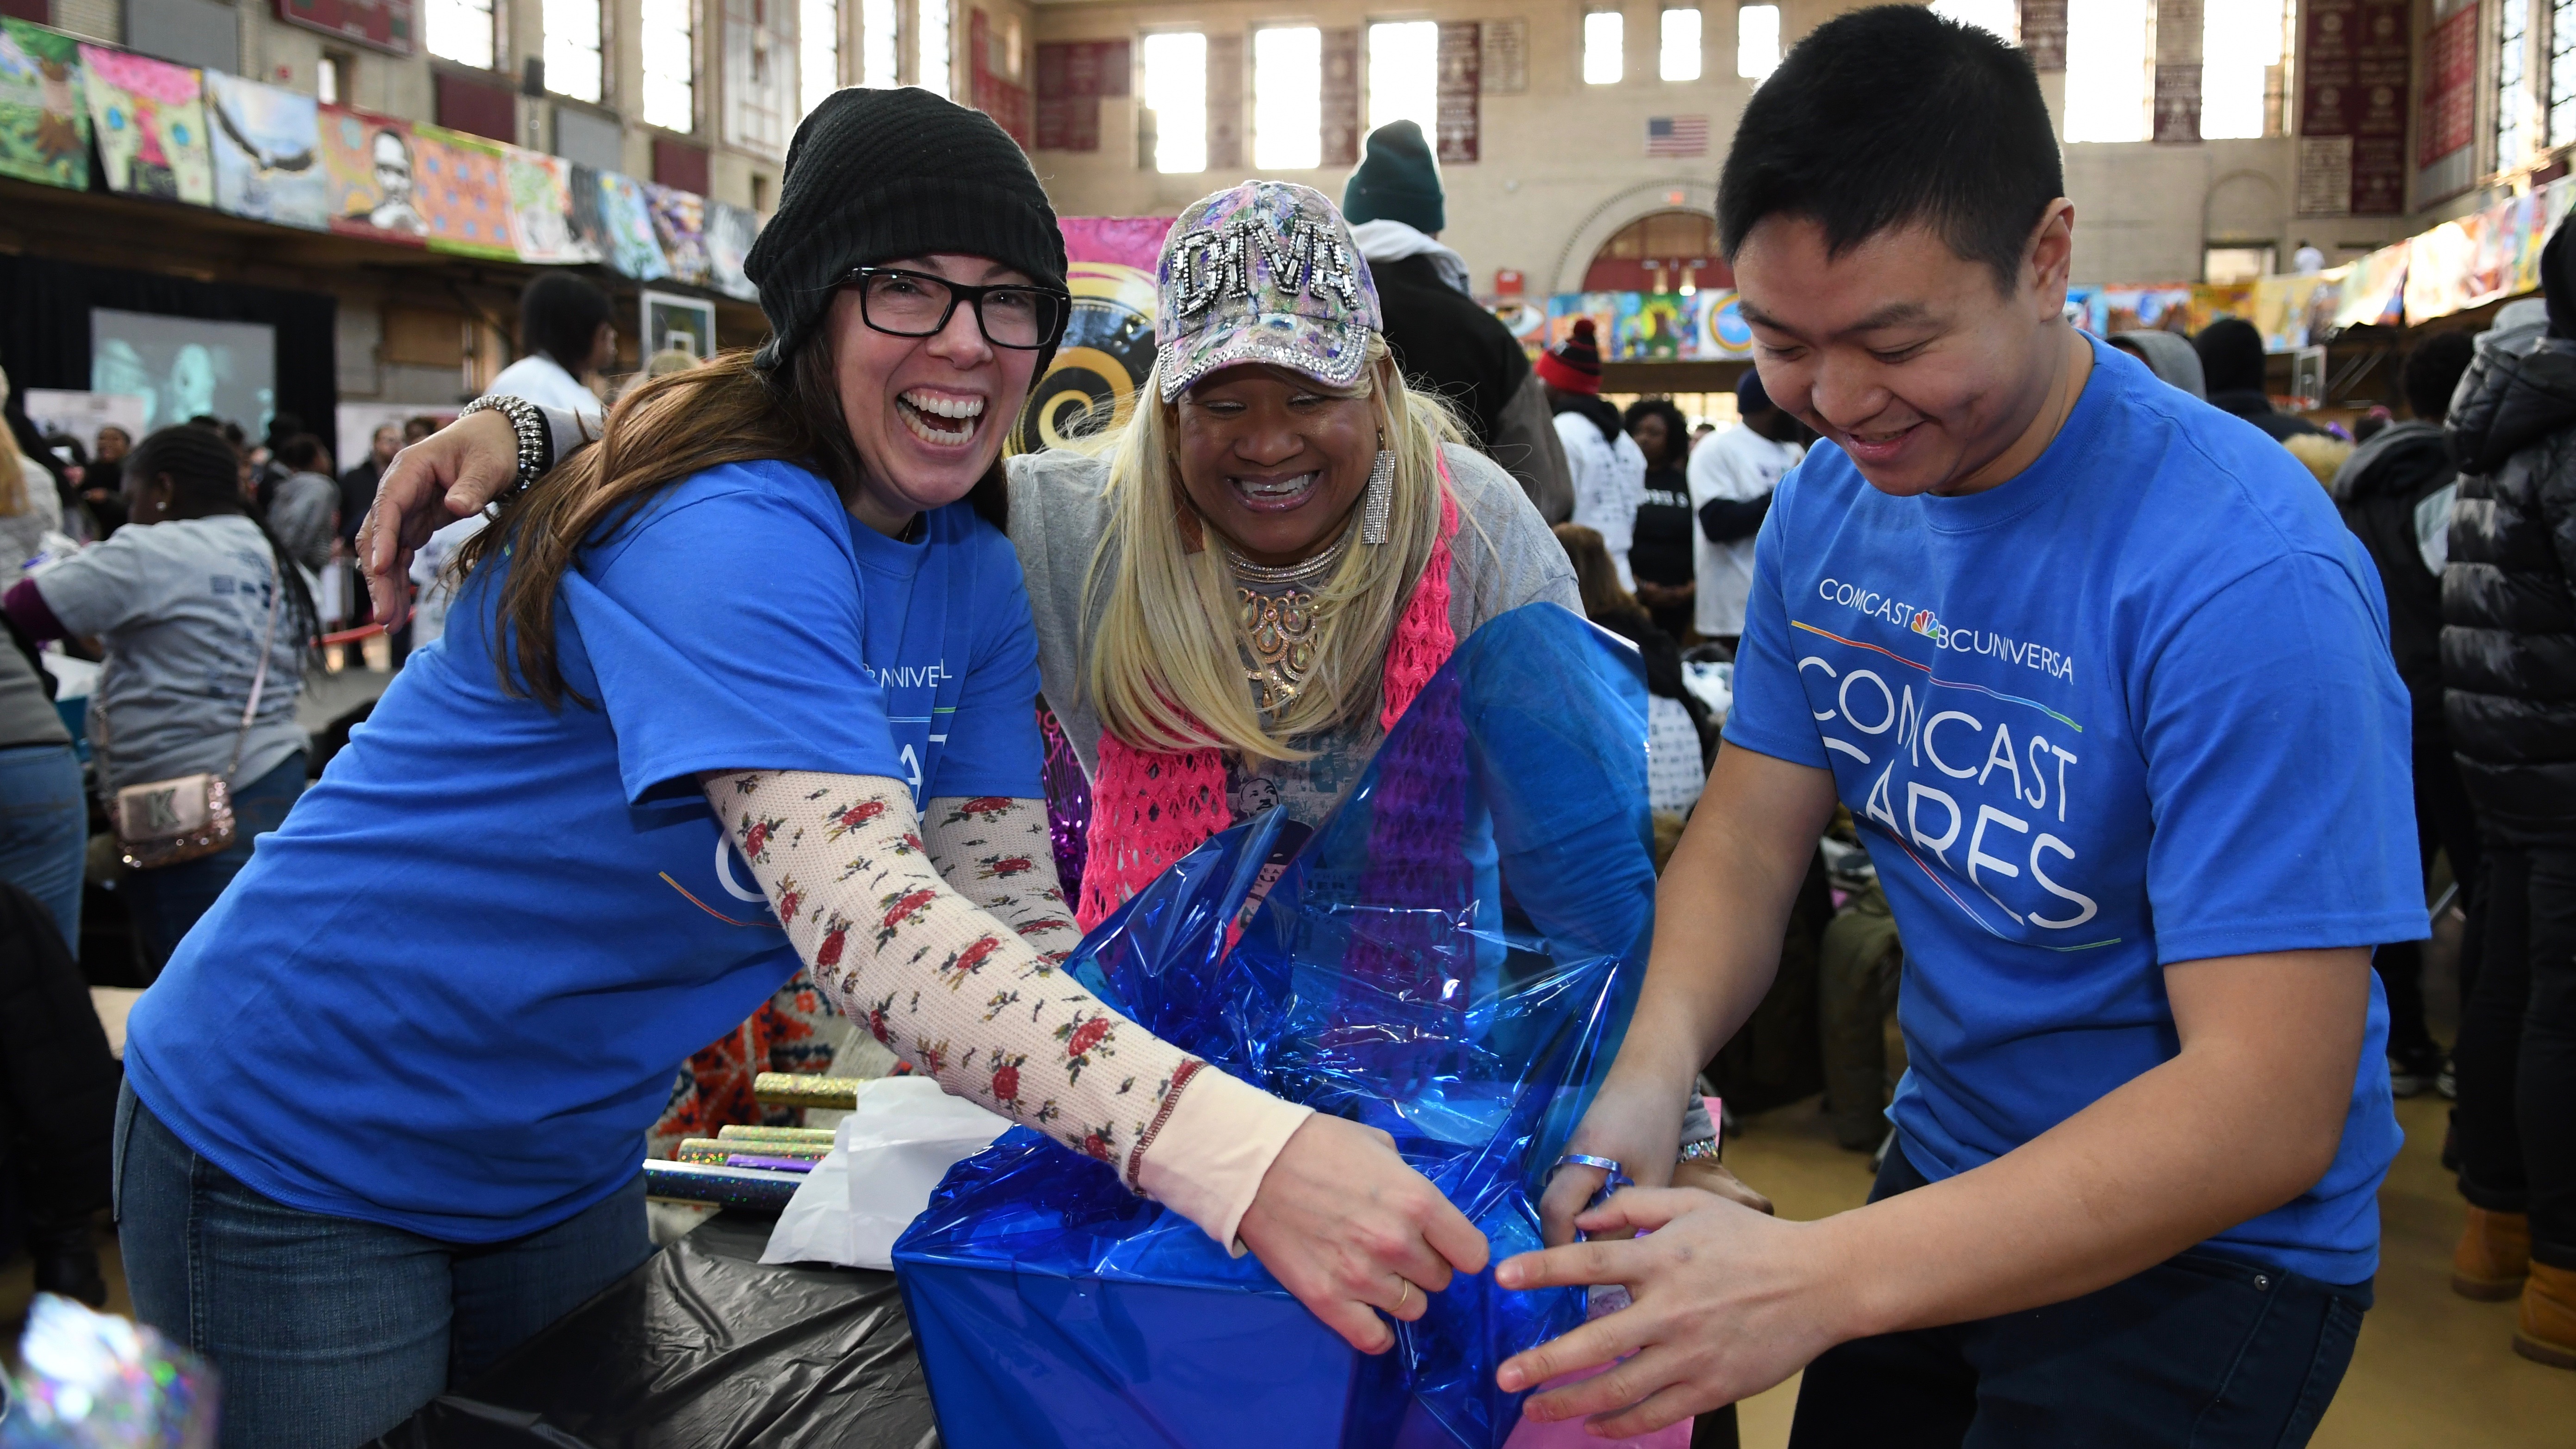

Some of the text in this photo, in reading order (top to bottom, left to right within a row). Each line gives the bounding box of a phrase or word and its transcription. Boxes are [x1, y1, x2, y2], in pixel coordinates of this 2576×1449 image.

[1174, 218, 1359, 318] DIVA
[1820, 578, 1914, 628] COMCAST
[1798, 656, 2077, 822] COMCAST
[146, 787, 180, 830] K
